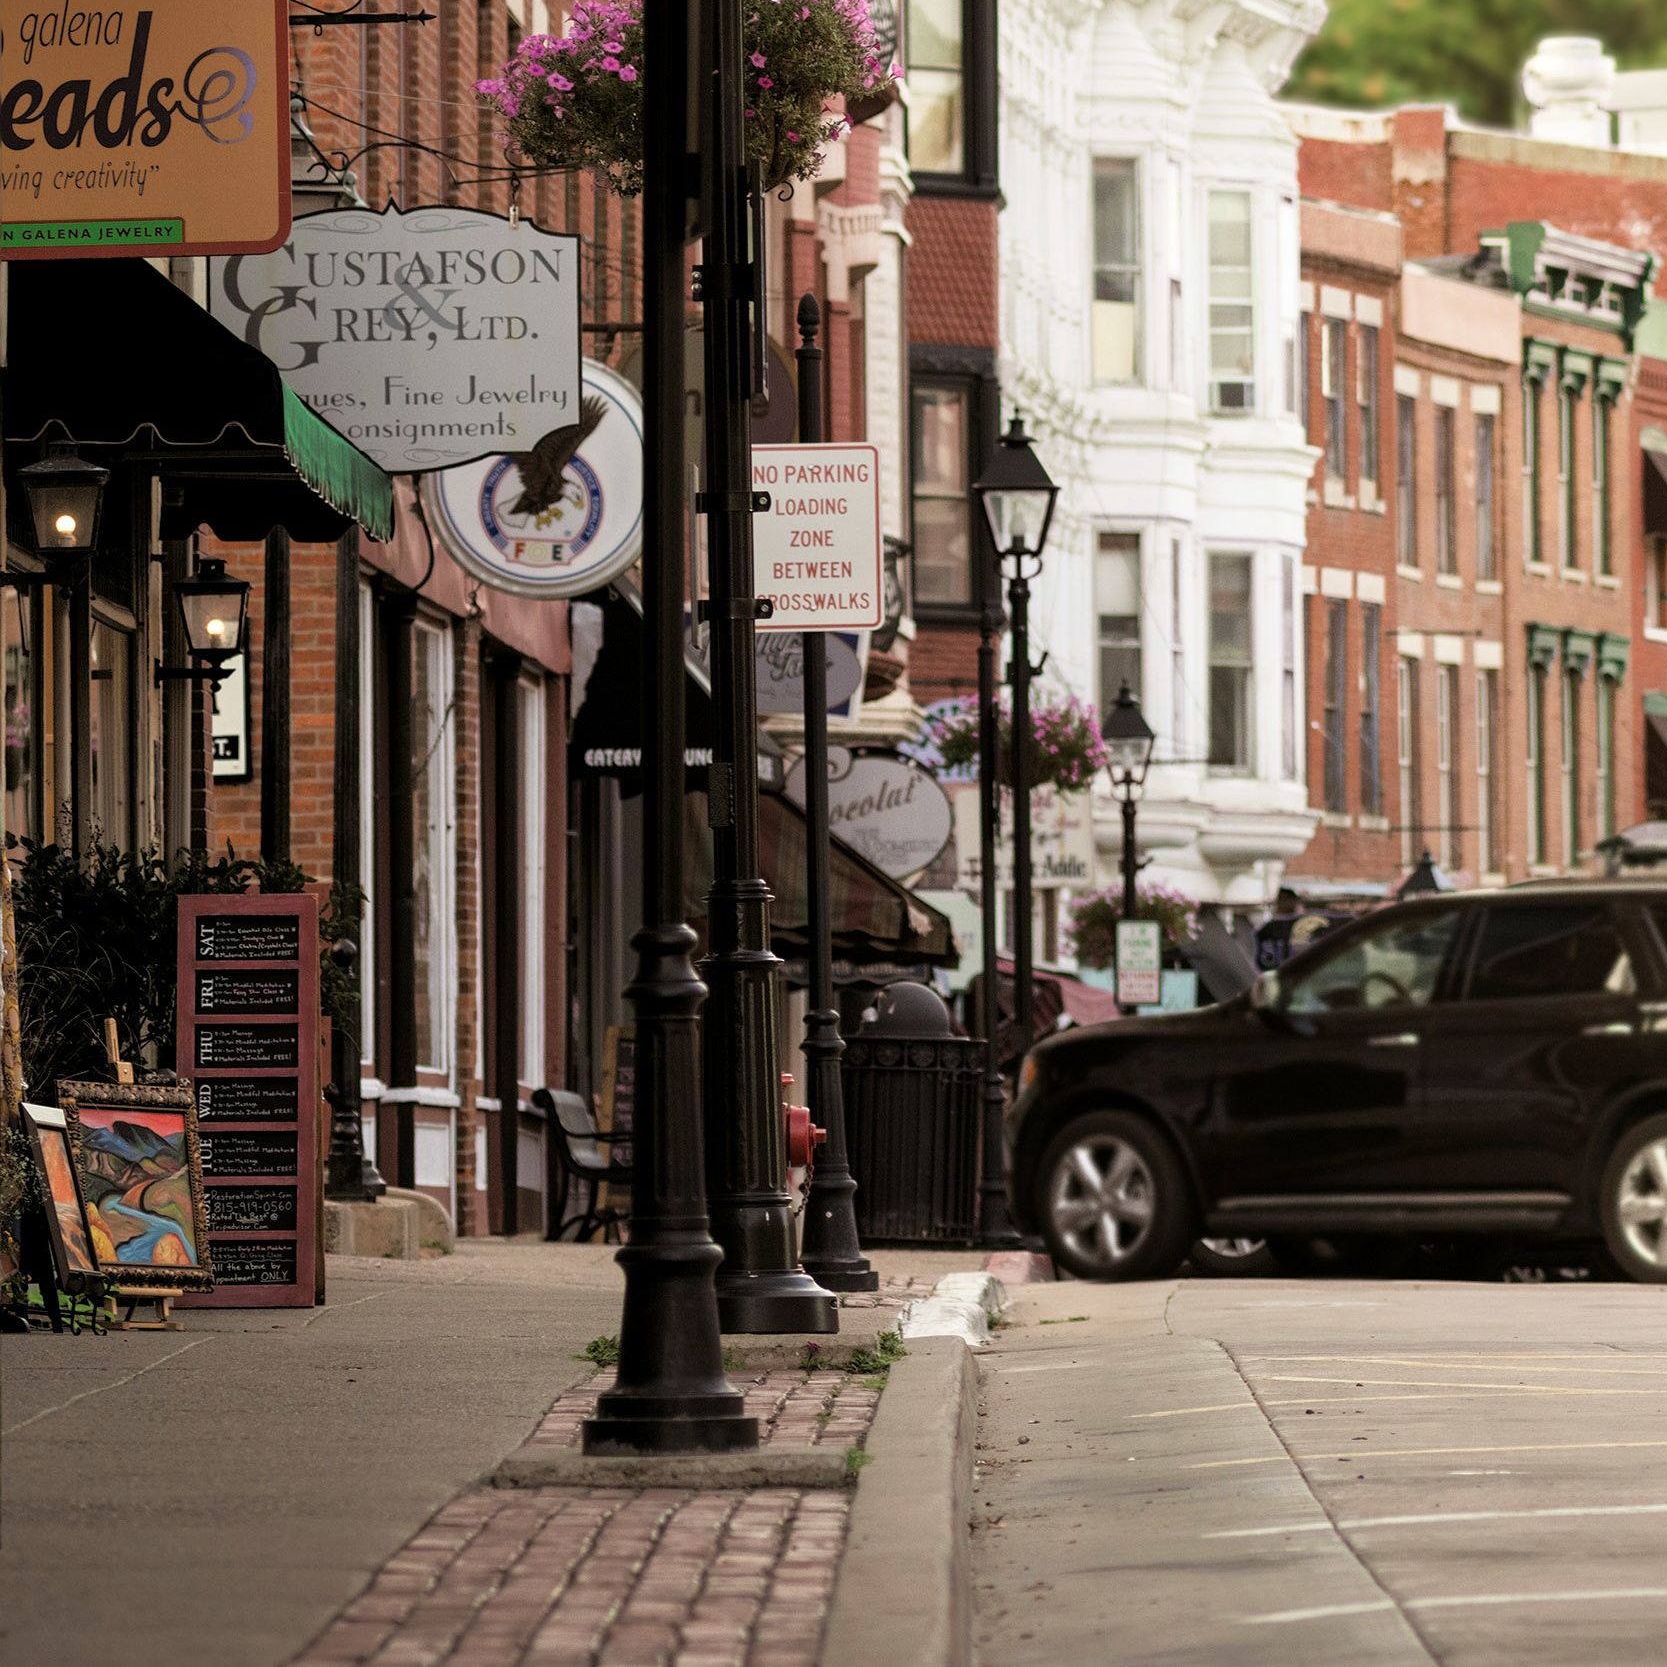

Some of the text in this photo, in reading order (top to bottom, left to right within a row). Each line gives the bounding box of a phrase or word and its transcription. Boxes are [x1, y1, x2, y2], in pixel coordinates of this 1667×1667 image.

[0, 10, 174, 151] eads
[21, 227, 92, 241] GALENA
[98, 224, 174, 240] JEWELRY
[222, 241, 563, 316] GUSTAFSON
[383, 375, 444, 406] Fine
[456, 374, 567, 411] Jewelry
[754, 464, 869, 484] NO PARKING
[775, 498, 848, 516] LOADING
[790, 530, 834, 548] ZONE
[773, 561, 852, 580] BETWEEN
[757, 592, 870, 612] ROSSWALKS
[584, 747, 642, 767] EATERY
[200, 924, 214, 956] SAT
[201, 978, 214, 1008] FRI
[200, 1031, 213, 1064] THU
[199, 1084, 212, 1119] WED
[211, 1262, 281, 1272] All the above by
[260, 1270, 289, 1281] ONLY
